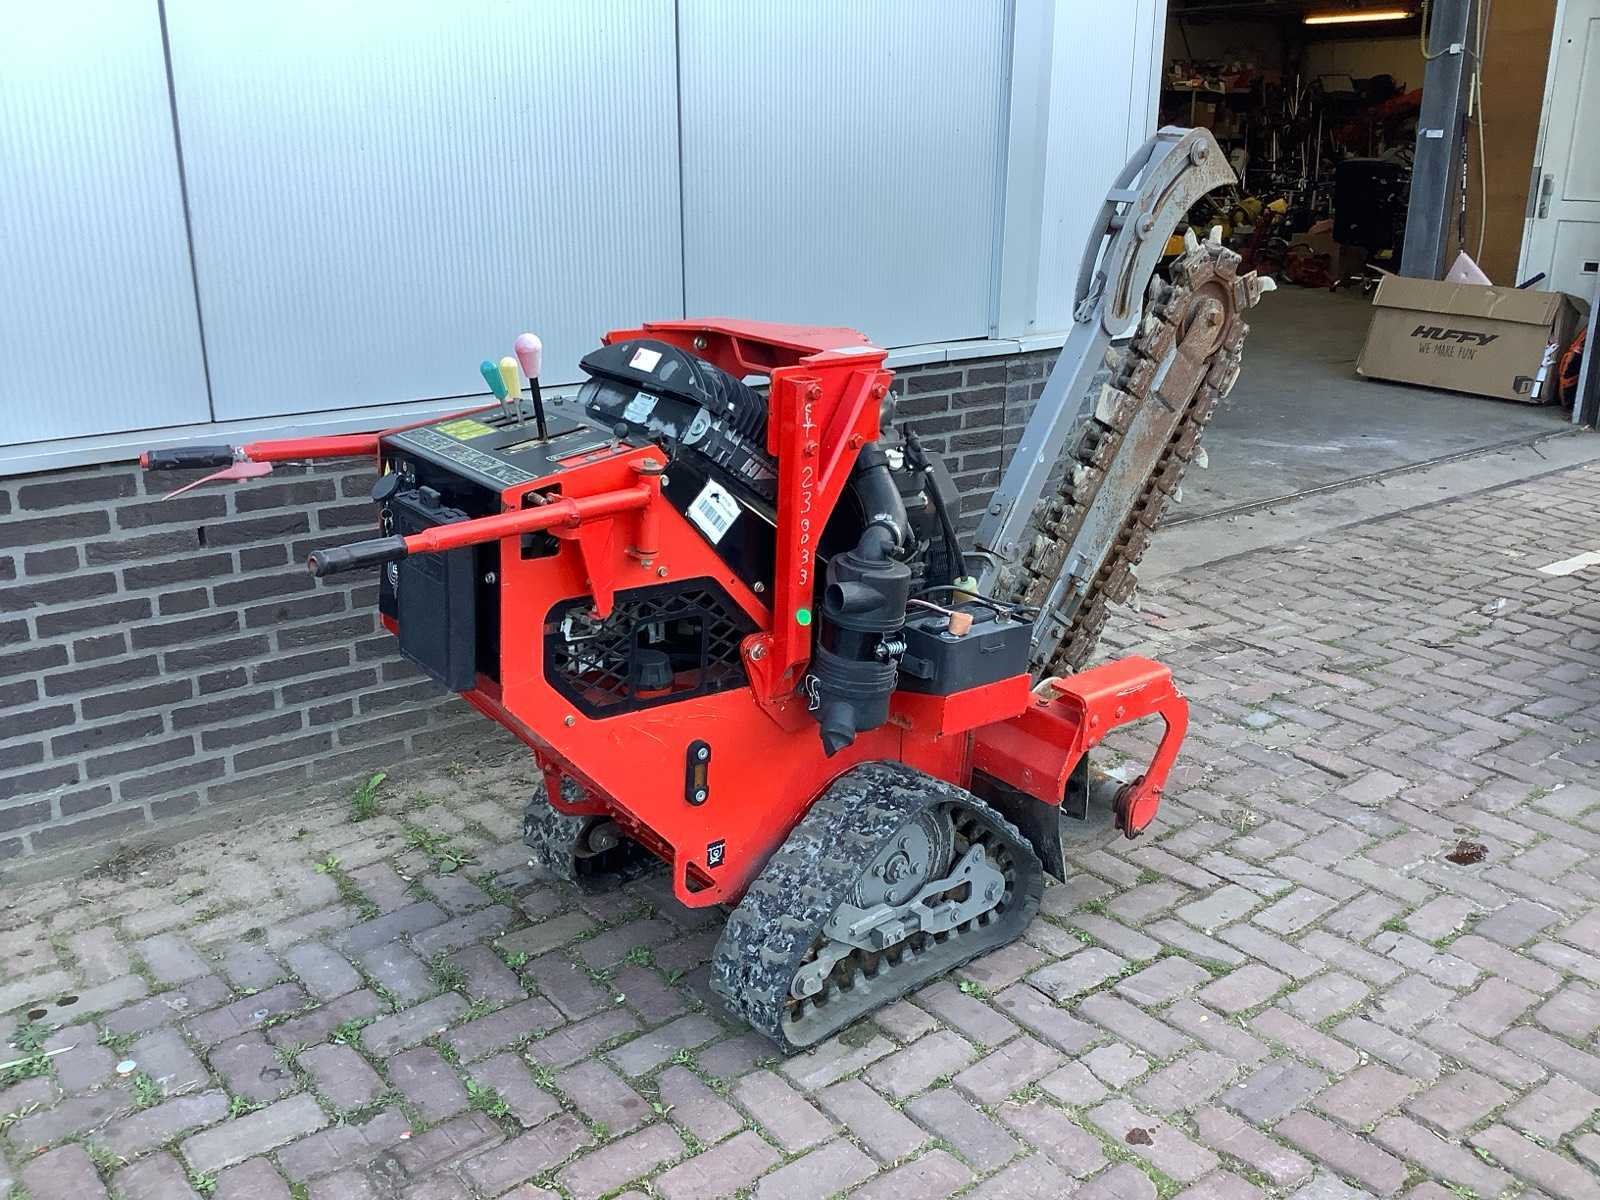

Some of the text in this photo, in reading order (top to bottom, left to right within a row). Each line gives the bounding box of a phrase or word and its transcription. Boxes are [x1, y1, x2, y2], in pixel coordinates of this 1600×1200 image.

[1411, 325, 1499, 345] HUFFY
[1418, 342, 1477, 360] WE MAKE FUN
